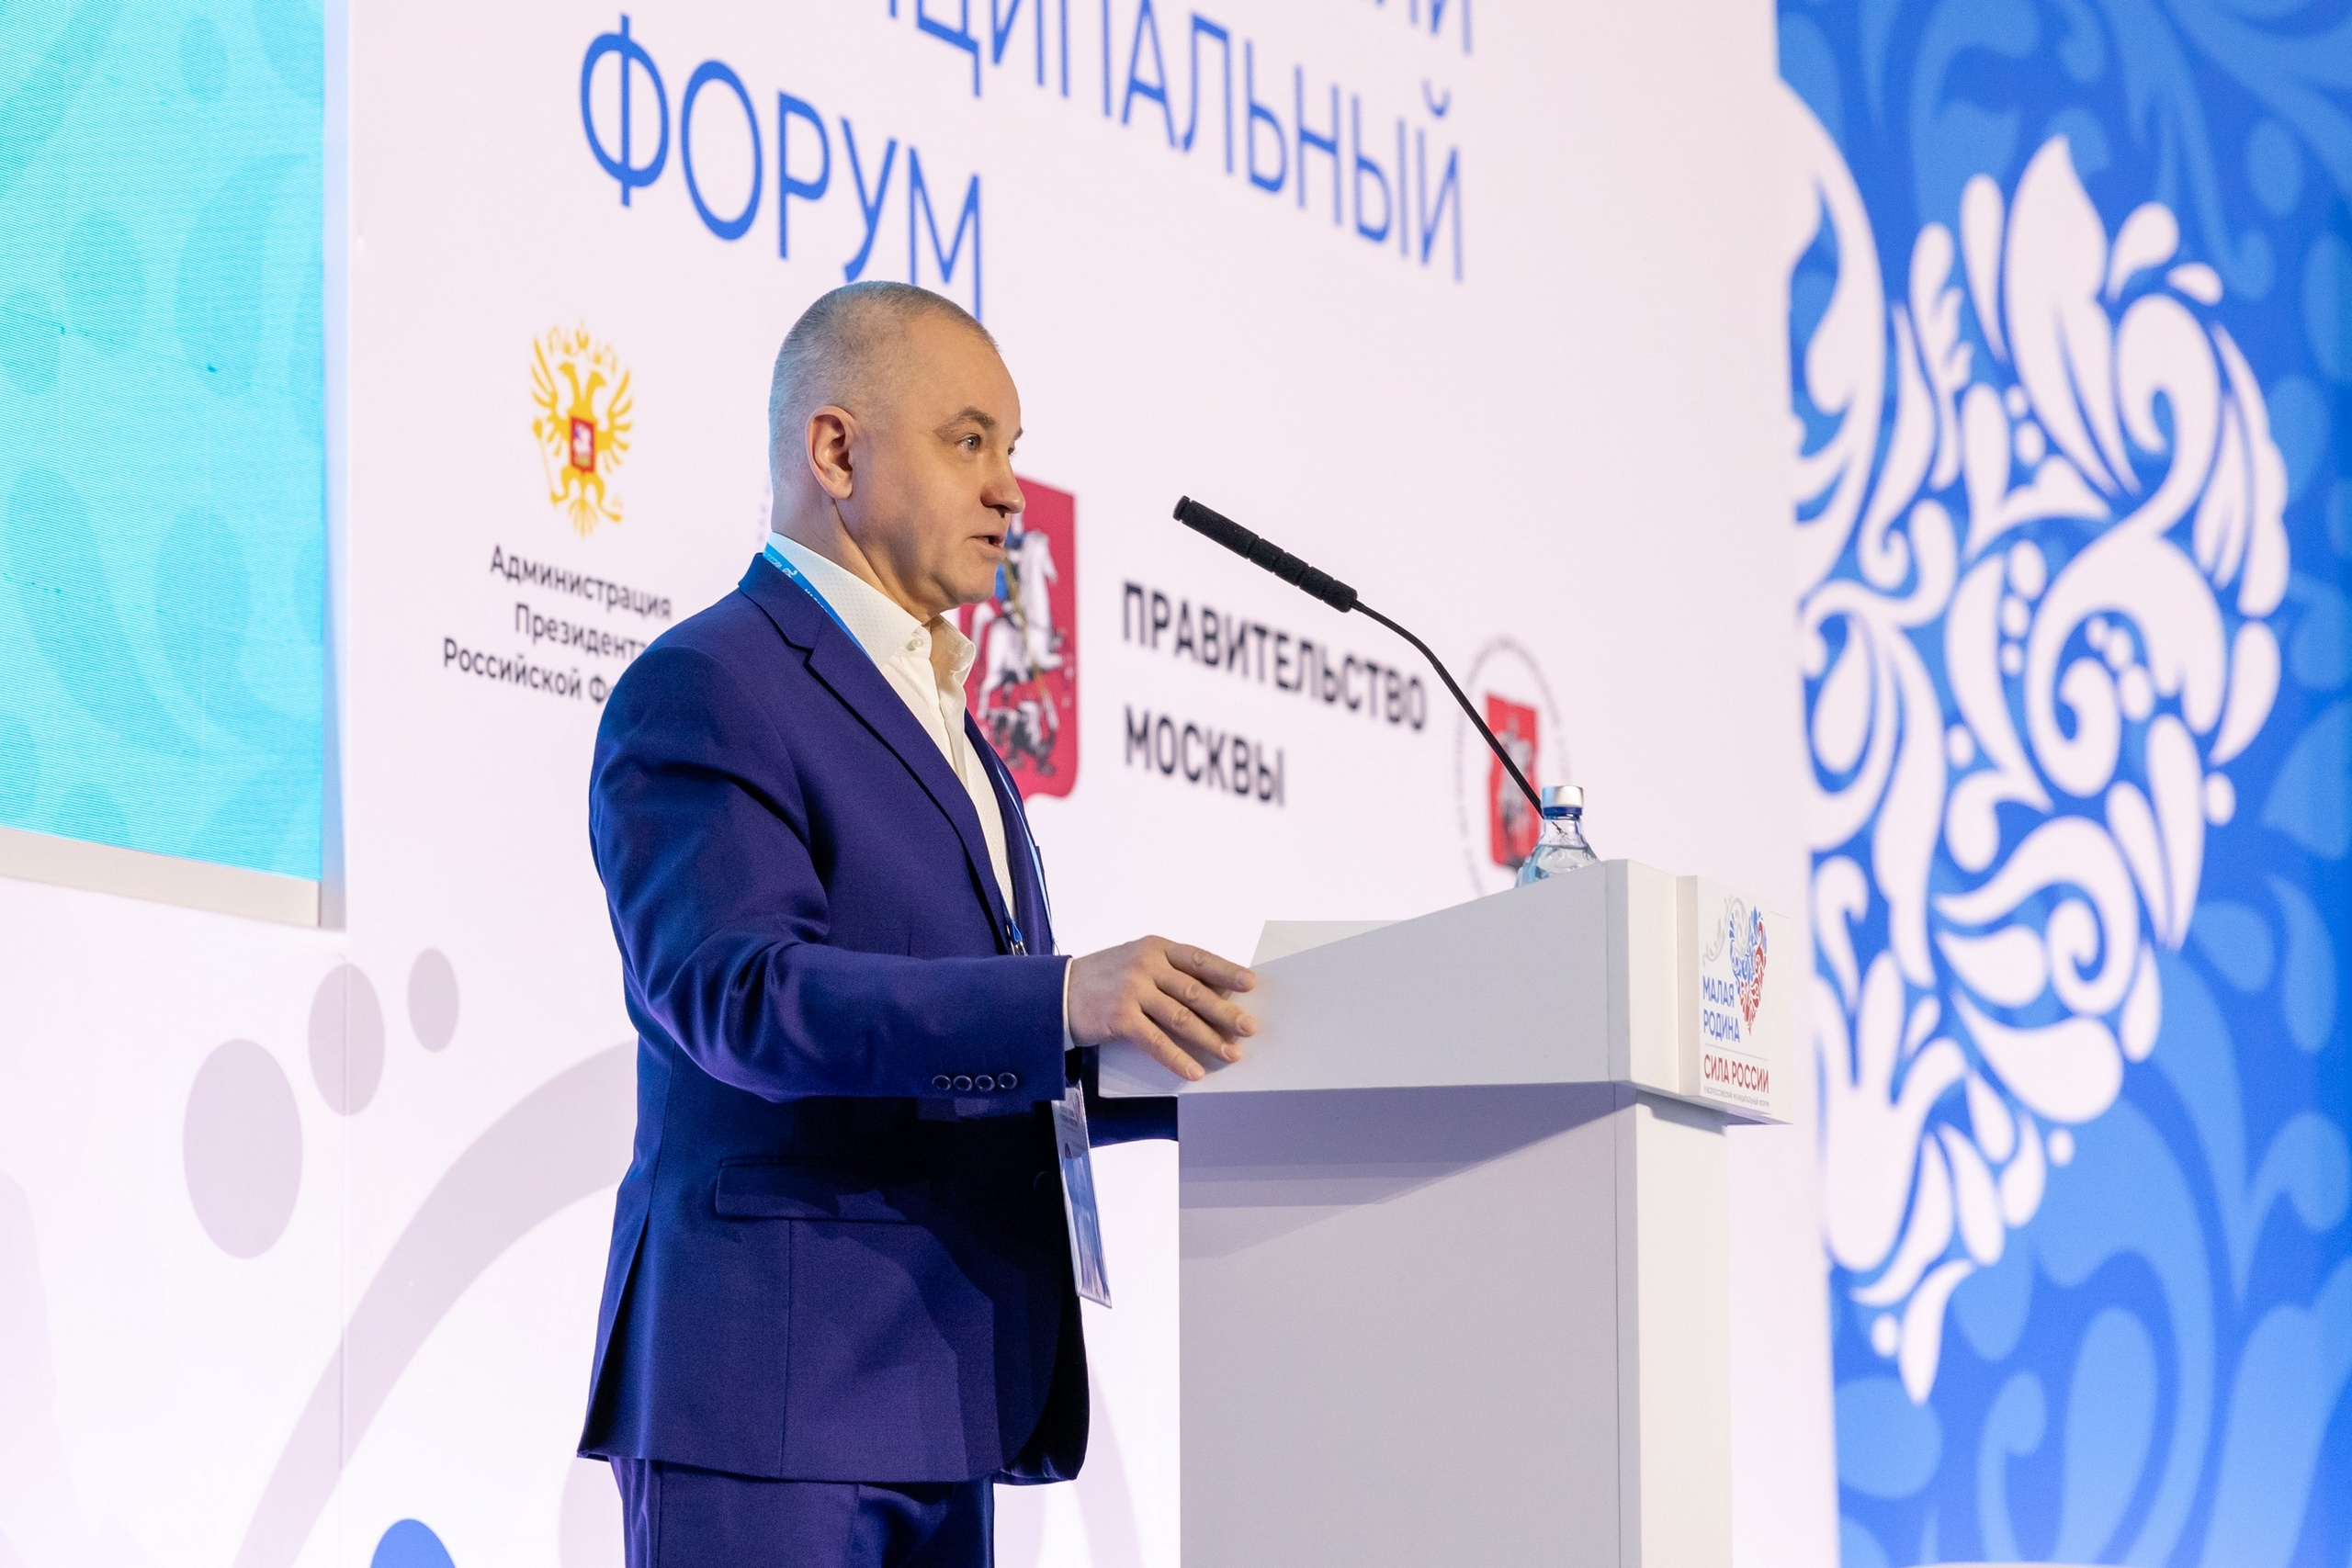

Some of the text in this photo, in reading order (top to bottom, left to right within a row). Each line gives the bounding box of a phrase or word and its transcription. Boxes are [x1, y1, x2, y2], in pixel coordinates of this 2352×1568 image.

[580, 13, 984, 323] ФОРУМ
[490, 544, 672, 620] Администрация
[514, 602, 646, 661] Президент
[1123, 581, 1428, 732] ПРАВИТЕЛЬСТВО
[443, 637, 582, 700] Российской
[1124, 704, 1285, 807] МОСКВЫ
[1702, 974, 1735, 1009] МАЛАЯ
[1702, 1009, 1741, 1043] РОДИНА
[1703, 1053, 1770, 1094] СИЛА РОССИИ
